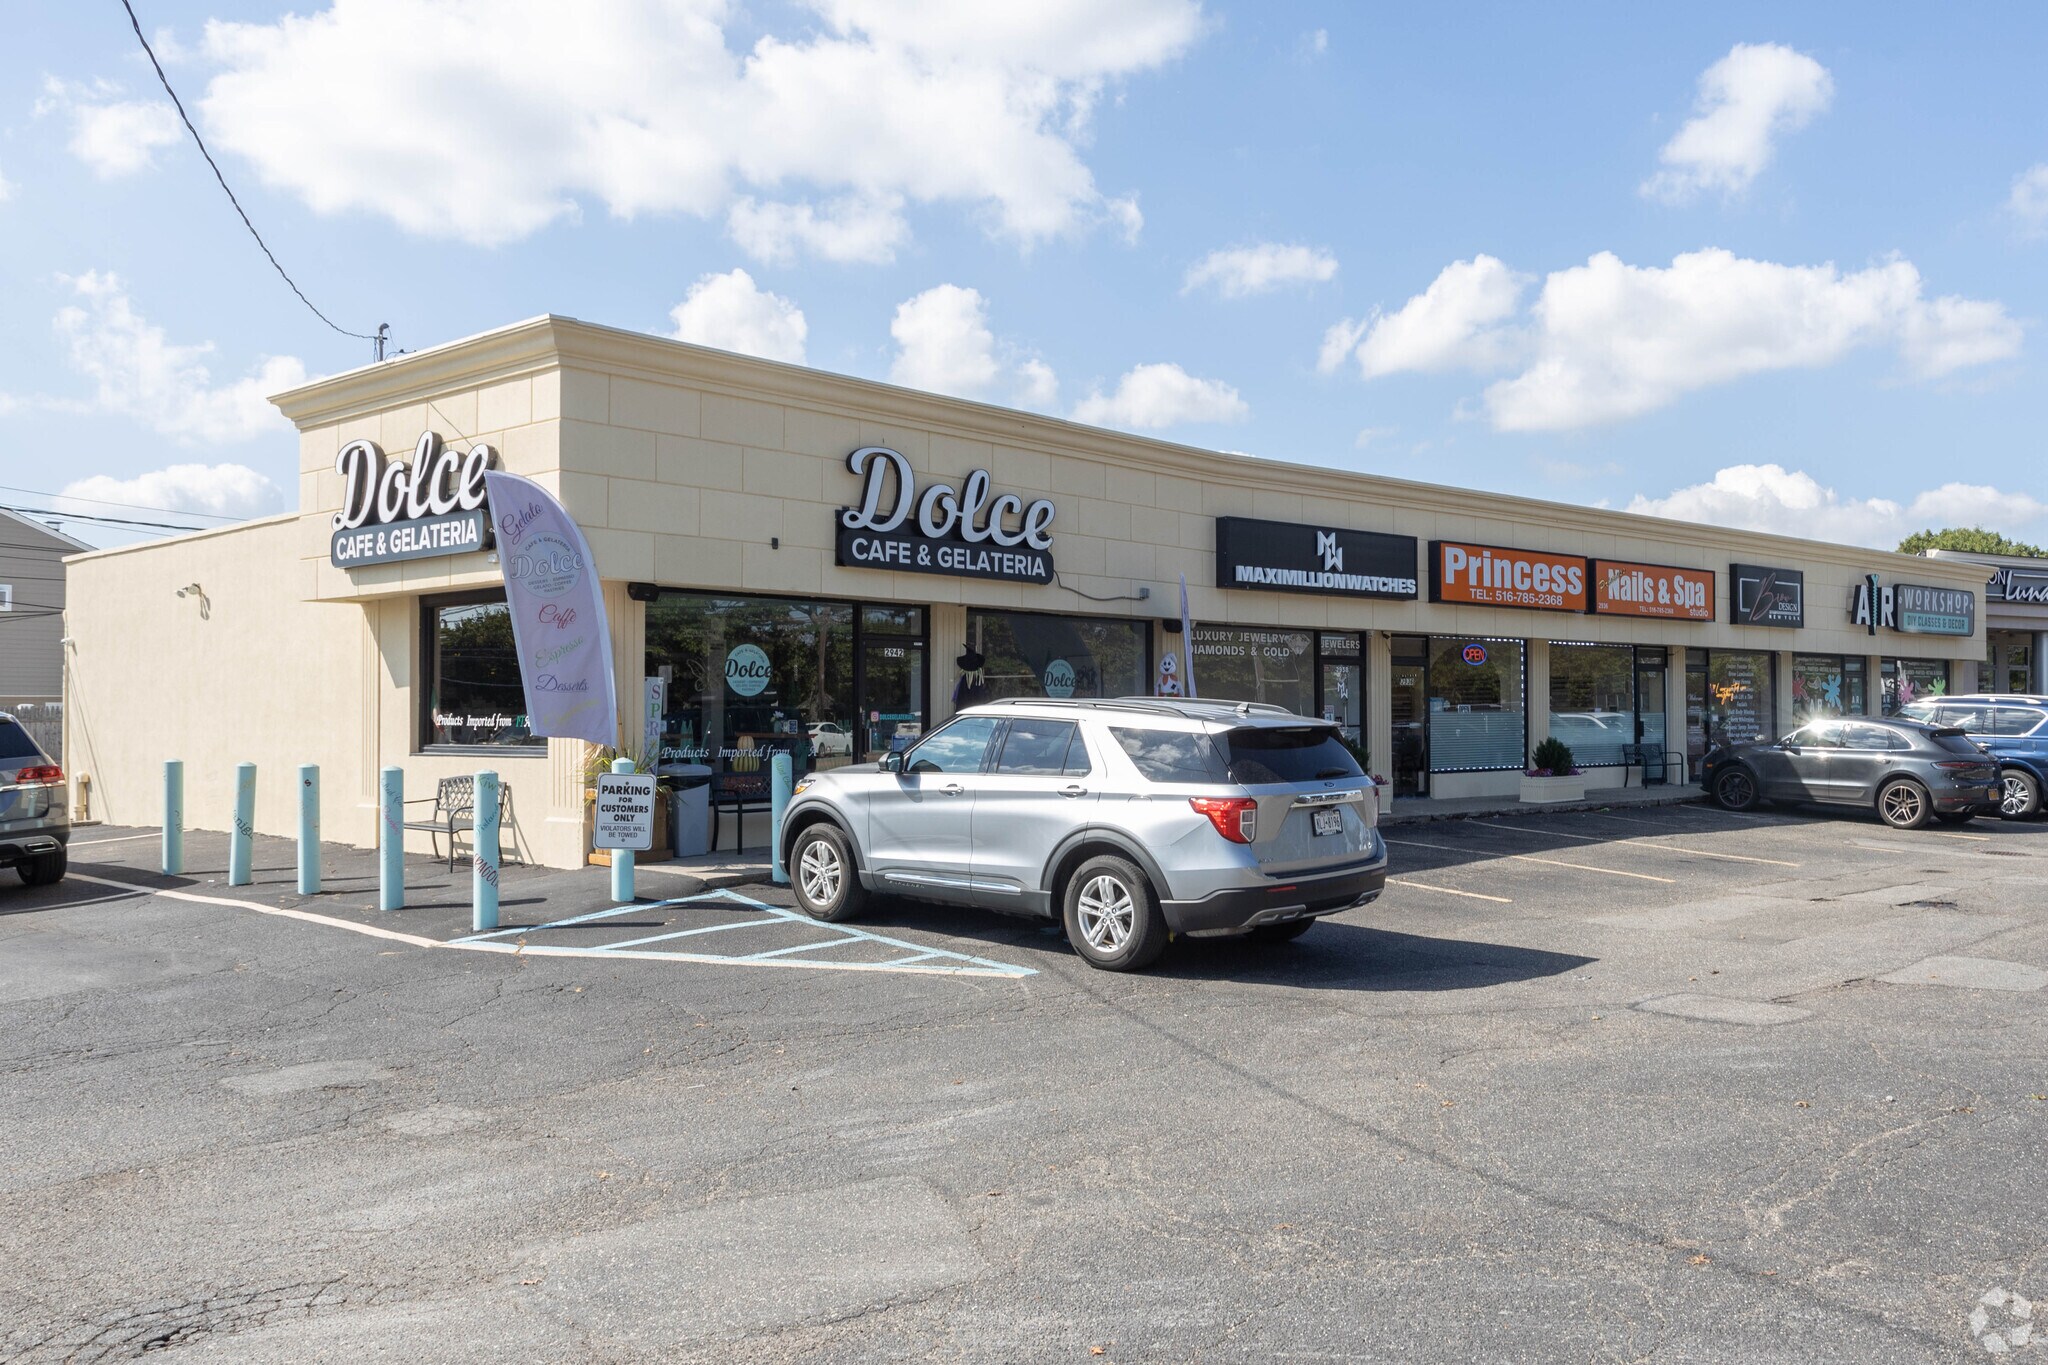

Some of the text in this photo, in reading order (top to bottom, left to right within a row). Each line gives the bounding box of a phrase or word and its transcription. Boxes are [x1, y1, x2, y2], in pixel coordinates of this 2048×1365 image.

[332, 430, 490, 531] Dolce
[843, 446, 1056, 550] Dolce
[500, 502, 543, 545] Gelato
[336, 518, 478, 560] CAFE & GELATERIA
[511, 550, 585, 580] Dolce
[851, 537, 1046, 577] CAFE & GELATERIA
[1444, 546, 1583, 596] Princess
[1469, 588, 1563, 607] TEL: 516-785-2368
[1608, 568, 1655, 603] Nails
[1658, 578, 1671, 604] &
[1673, 575, 1705, 609] Spa
[1778, 602, 1798, 612] DESIGN
[1903, 588, 1969, 614] WORKSHOP
[1689, 608, 1709, 617] studio
[1917, 616, 1941, 629] CLASSES
[1191, 631, 1286, 644] LUXURY JEWELRY
[1320, 639, 1361, 650] JEWELERS
[535, 636, 585, 669] Espresso
[884, 648, 904, 657] 2942
[1250, 646, 1258, 656] &
[1263, 647, 1290, 657] GOLD
[1464, 648, 1485, 661] OPEN
[724, 658, 773, 678] Dolce
[1045, 670, 1077, 688] Dolce
[436, 713, 464, 726] Products
[466, 713, 496, 731] Imported
[494, 713, 512, 731] from
[661, 744, 710, 759] Products
[717, 744, 764, 762] Imported
[601, 785, 651, 796] PARKING
[600, 804, 649, 813] CUSTOMERS
[613, 814, 636, 822] ONLY
